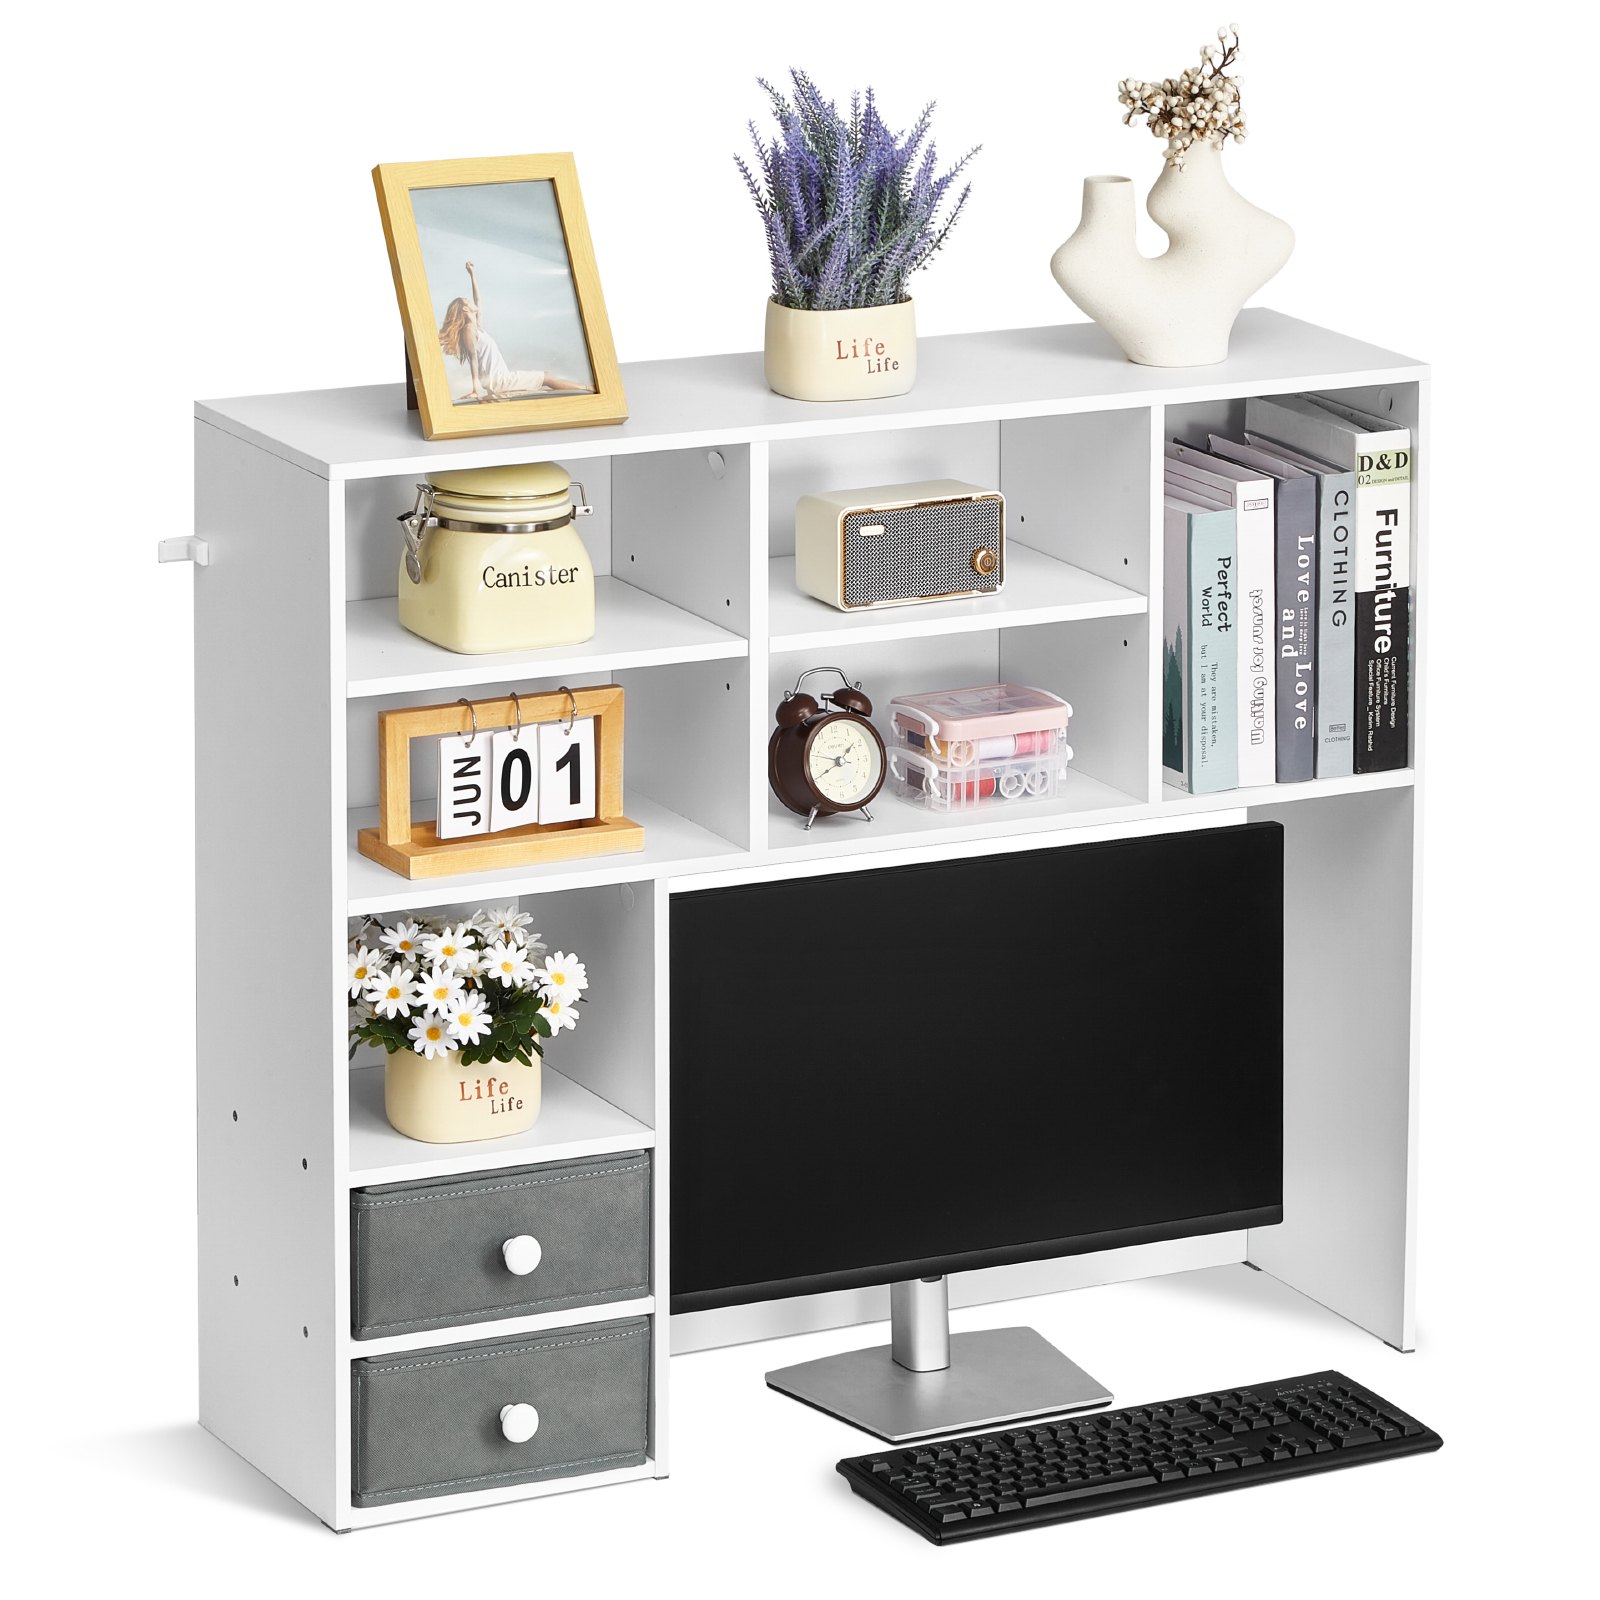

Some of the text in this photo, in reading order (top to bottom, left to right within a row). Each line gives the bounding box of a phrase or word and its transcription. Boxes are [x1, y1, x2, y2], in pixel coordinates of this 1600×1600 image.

[836, 338, 886, 360] Life
[867, 357, 900, 374] Life
[1358, 475, 1371, 485] 02
[1332, 490, 1349, 627] CLOTHING
[482, 566, 579, 588] Canister
[1374, 508, 1399, 654] Furniture
[1217, 556, 1232, 633] Perfect
[1201, 586, 1214, 628] World
[1281, 535, 1315, 730] Love and Love
[1200, 644, 1208, 659] but
[1210, 662, 1219, 682] They
[1249, 589, 1267, 745] Waiting for sunset
[1201, 673, 1206, 684] am
[1201, 688, 1207, 698] at
[1199, 702, 1207, 722] your
[1210, 706, 1218, 747] mistaken,
[1199, 726, 1208, 768] disposal.
[453, 756, 482, 826] JUN
[459, 1078, 509, 1101] Life
[490, 1097, 523, 1115] Life
